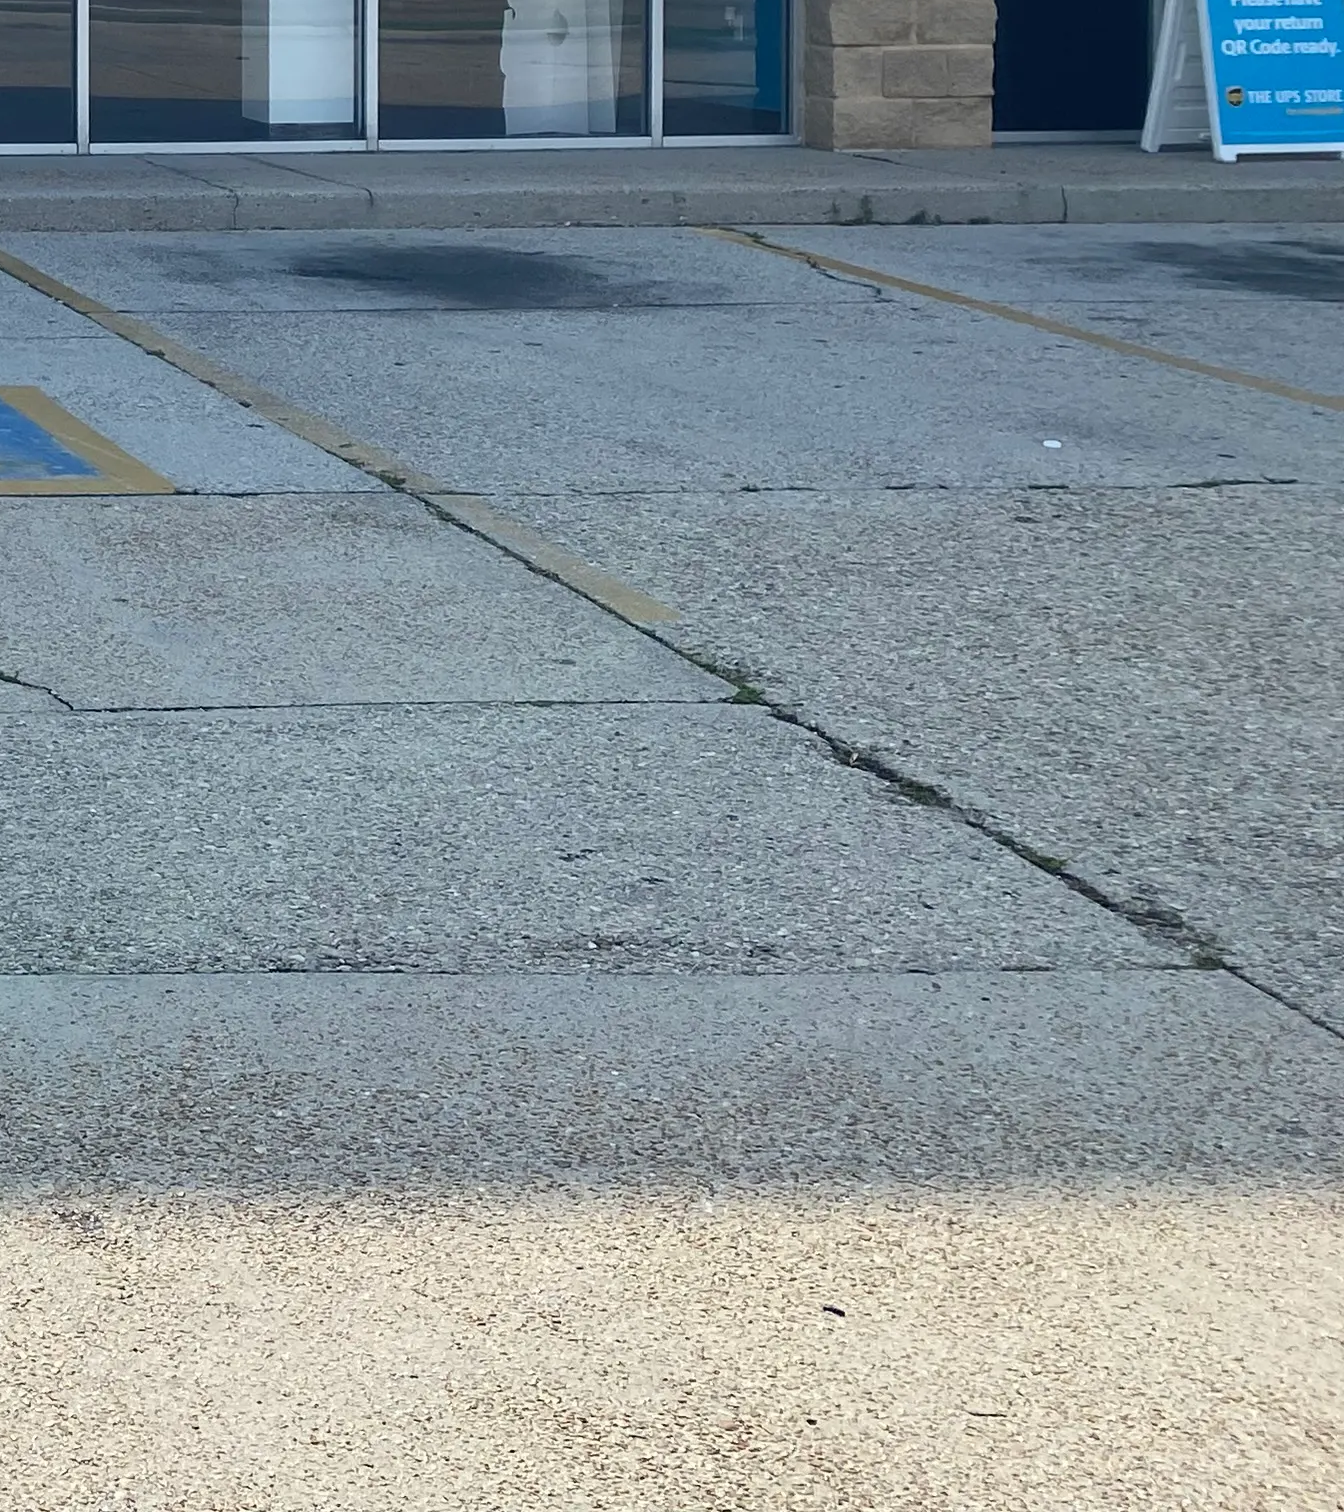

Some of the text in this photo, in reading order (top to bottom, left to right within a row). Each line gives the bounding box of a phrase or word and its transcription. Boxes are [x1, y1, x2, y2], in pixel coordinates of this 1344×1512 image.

[1233, 16, 1324, 35] your return
[1221, 37, 1342, 57] QR Code ready.
[1248, 90, 1272, 103] THE
[1275, 90, 1301, 103] UPS
[1304, 89, 1344, 103] STORE
